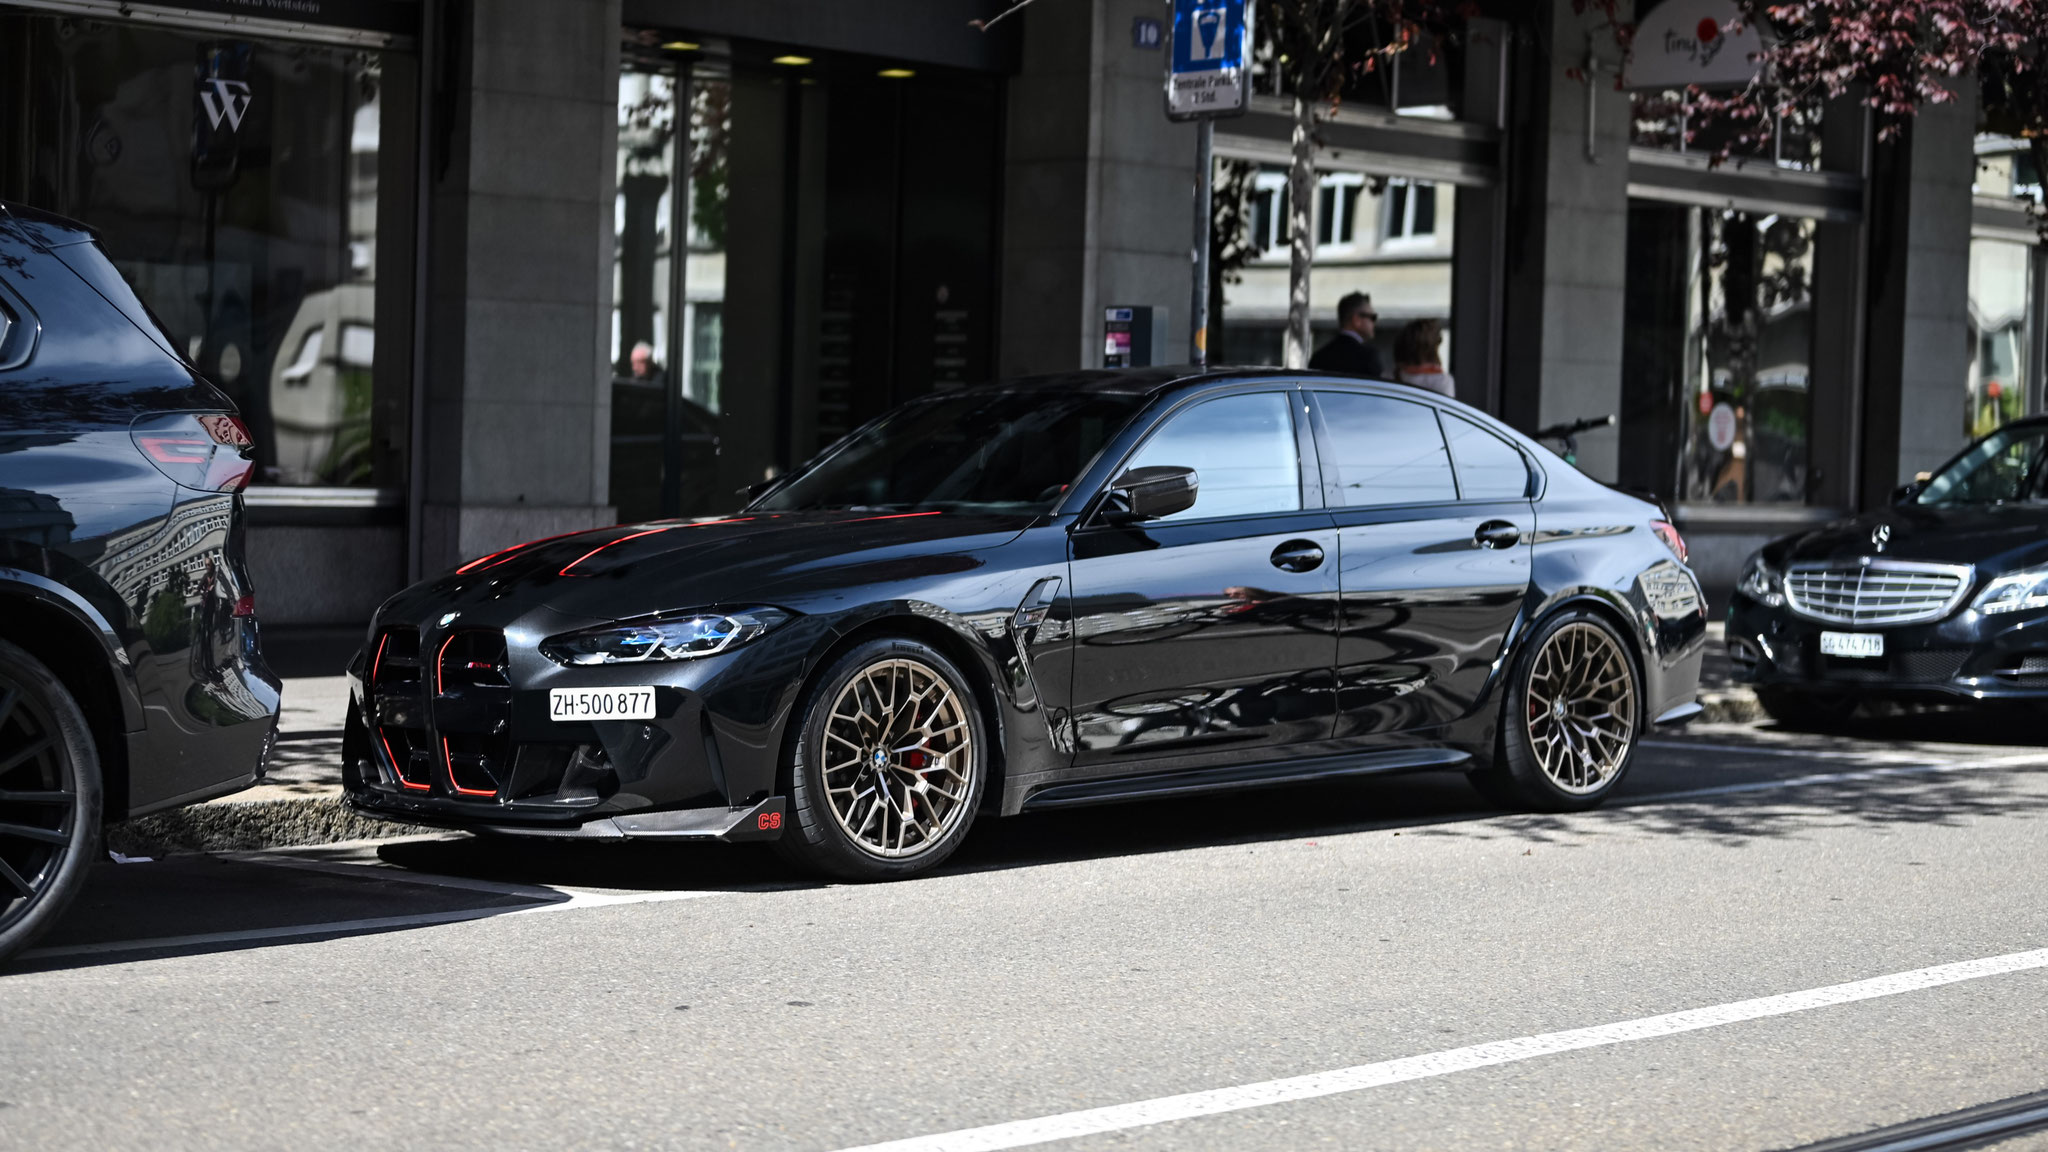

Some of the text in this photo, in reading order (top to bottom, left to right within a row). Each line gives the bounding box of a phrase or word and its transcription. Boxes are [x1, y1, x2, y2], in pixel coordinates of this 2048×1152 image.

[1139, 23, 1158, 44] 10
[1664, 27, 1697, 61] tiny
[1173, 74, 1241, 91] Zentrale Parkur
[1201, 90, 1217, 104] Std.
[617, 692, 651, 714] 877
[758, 812, 781, 830] CS
